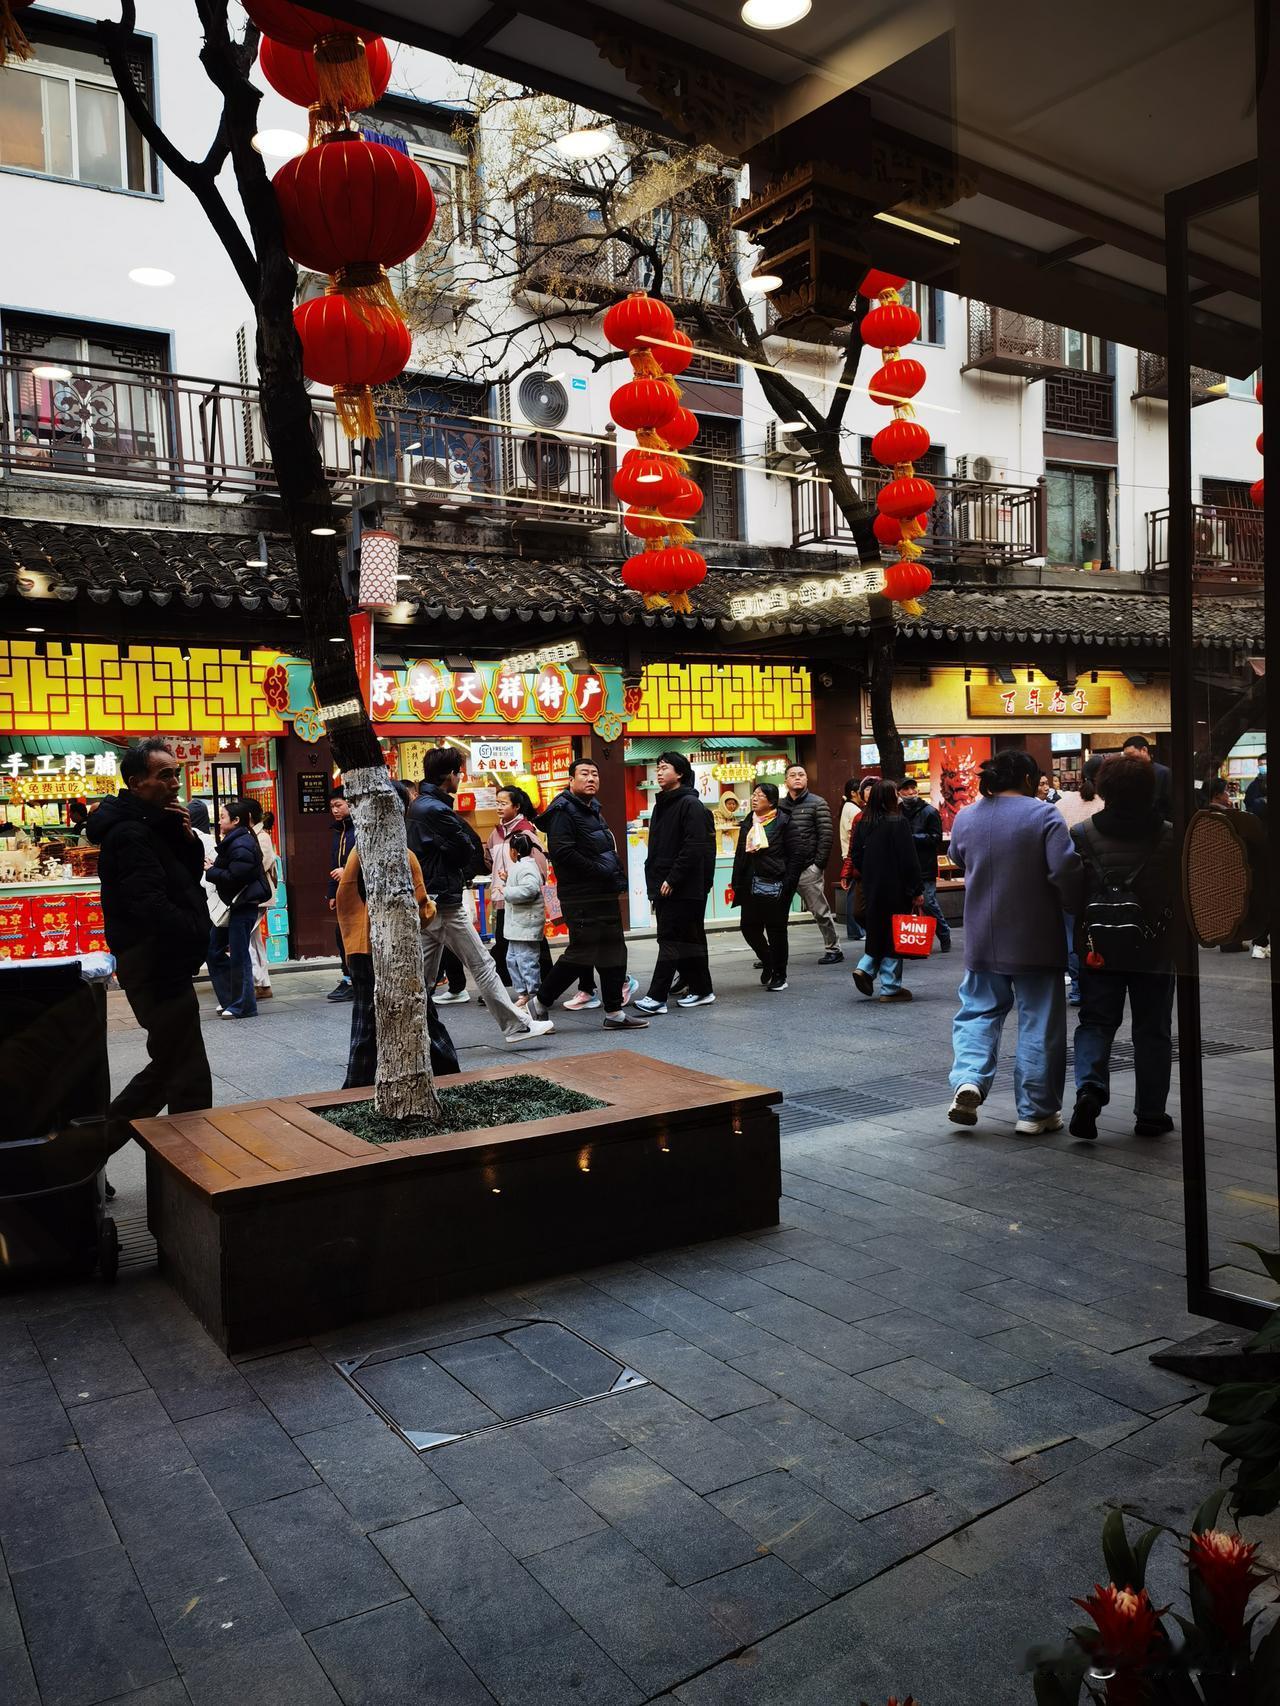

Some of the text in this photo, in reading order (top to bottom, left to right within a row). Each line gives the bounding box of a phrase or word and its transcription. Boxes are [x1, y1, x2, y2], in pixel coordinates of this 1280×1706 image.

[372, 672, 602, 710] 京新天祥特产
[1, 750, 118, 779] 手工肉脯
[477, 759, 518, 770] 全国包邮
[28, 780, 80, 794] 免费试吃
[42, 912, 69, 925] 南京
[900, 921, 927, 933] MINI
[43, 939, 69, 952] 南京
